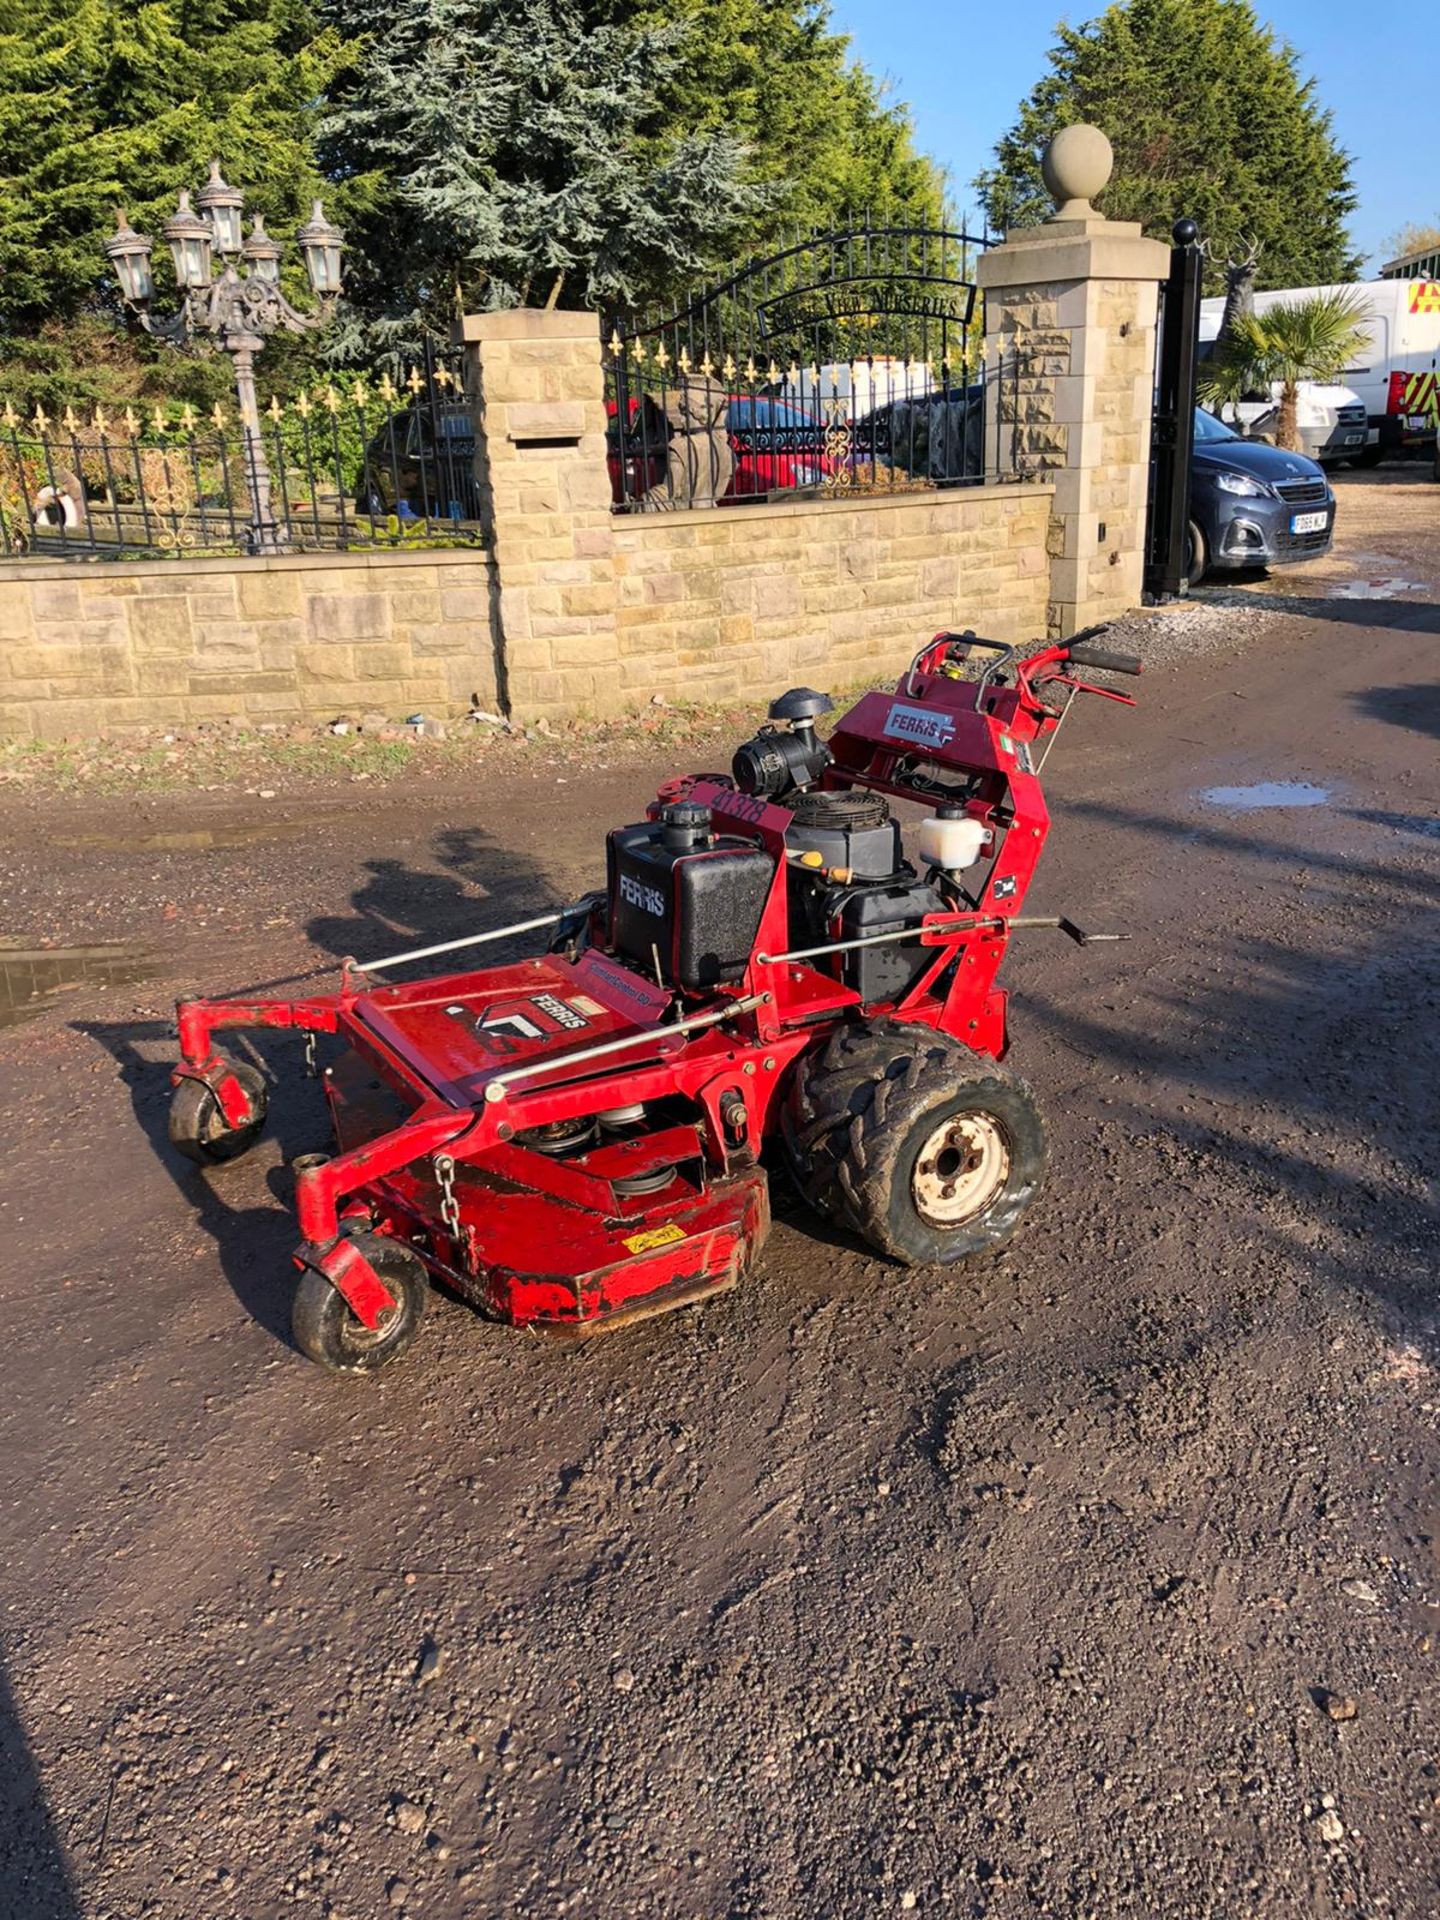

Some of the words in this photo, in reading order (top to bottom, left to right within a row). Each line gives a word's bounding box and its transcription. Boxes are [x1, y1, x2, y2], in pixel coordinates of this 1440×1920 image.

[891, 713, 939, 737] FERRIS
[712, 789, 768, 825] 41378
[620, 874, 665, 917] FERRIS
[531, 994, 587, 1030] FERRIS
